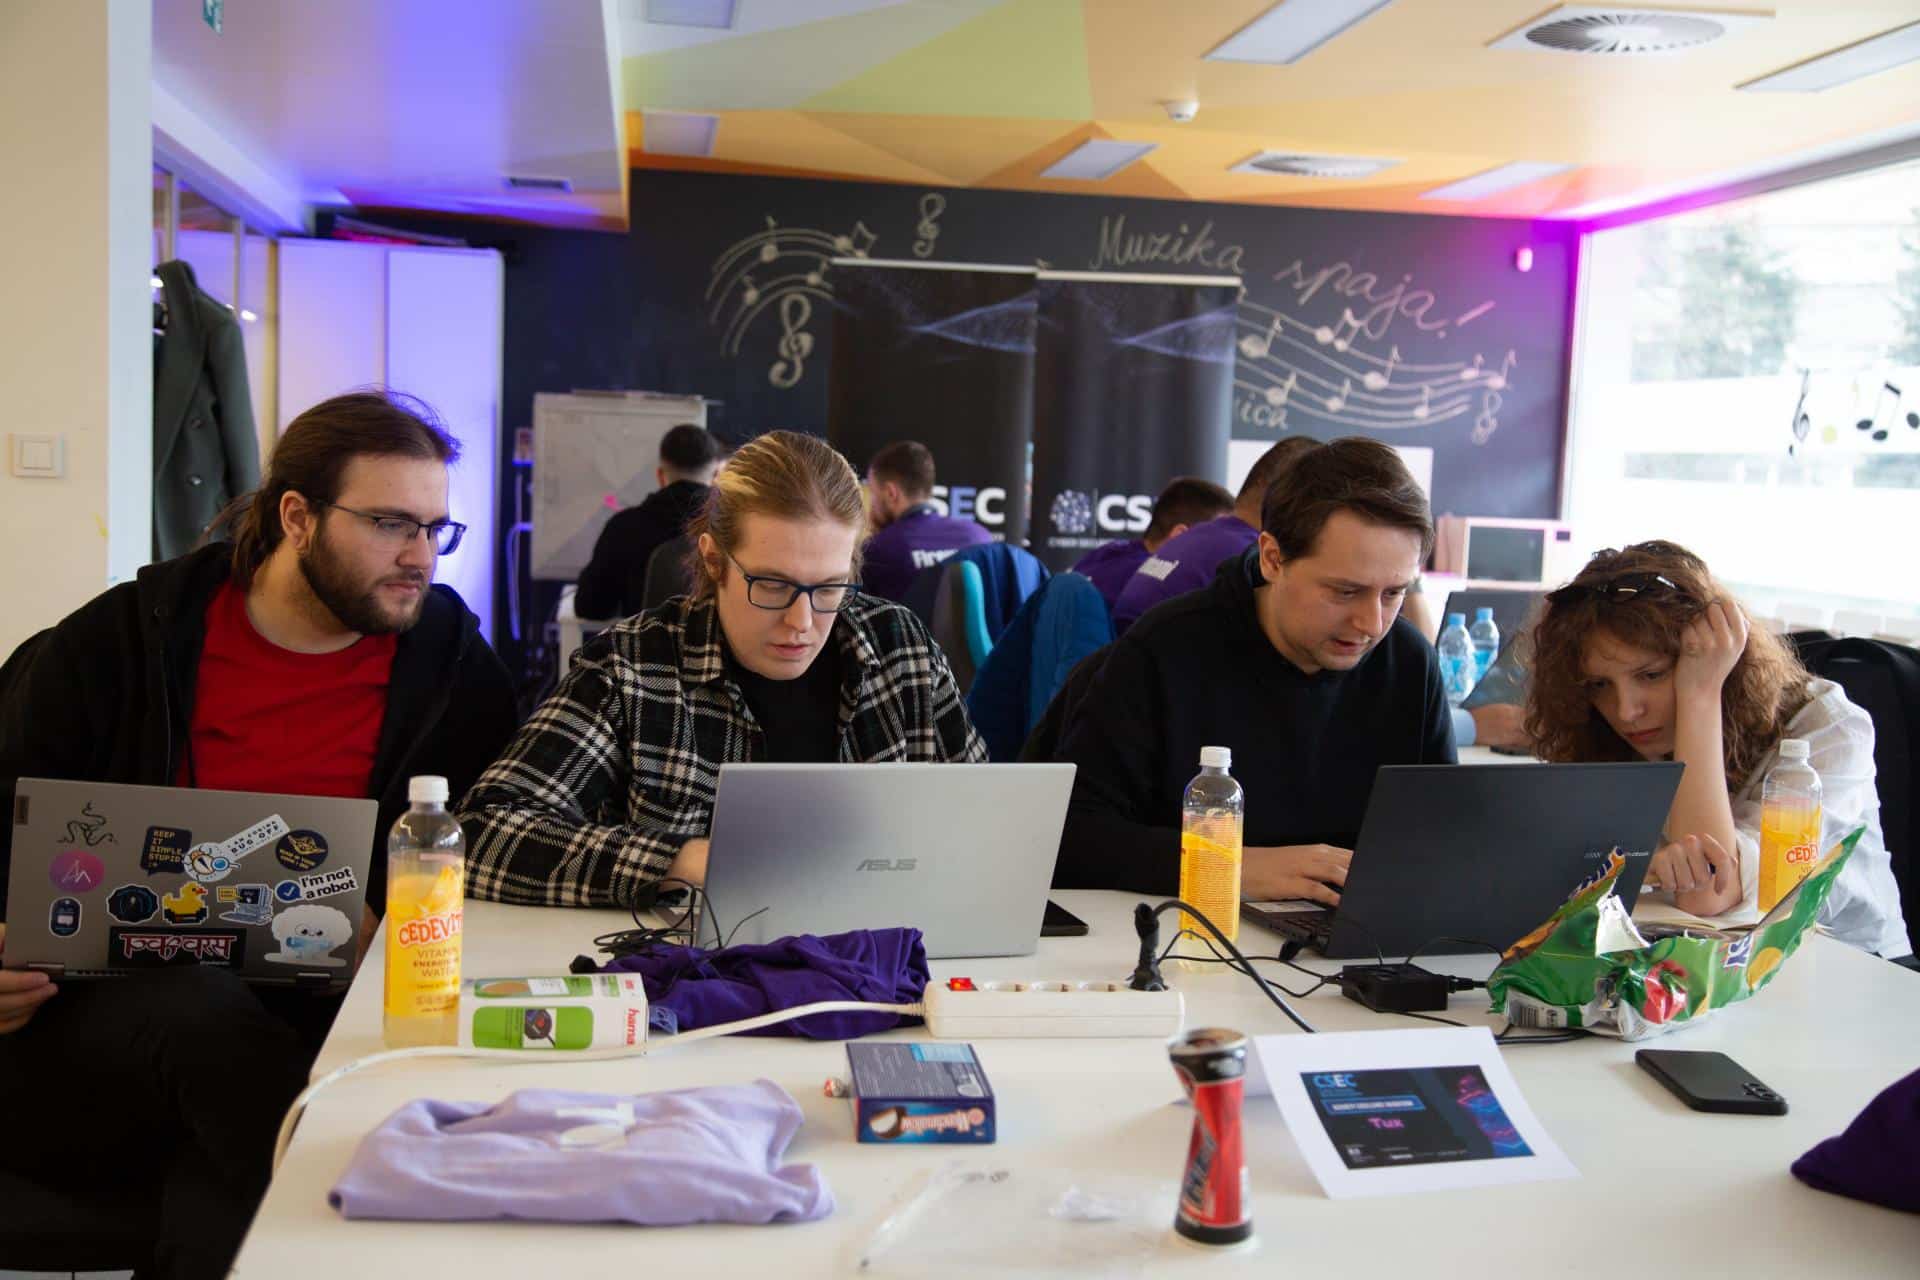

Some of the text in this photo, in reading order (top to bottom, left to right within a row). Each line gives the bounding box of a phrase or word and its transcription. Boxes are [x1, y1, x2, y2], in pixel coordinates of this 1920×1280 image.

[1090, 214, 1244, 274] Muzika
[1235, 393, 1289, 431] ica
[1097, 493, 1156, 533] CS
[856, 858, 918, 872] ASUS
[301, 868, 352, 887] I'm not
[306, 879, 357, 899] a robot
[626, 1008, 640, 1046] hama
[1313, 1074, 1357, 1089] CSEC
[1367, 1117, 1405, 1129] Tux
